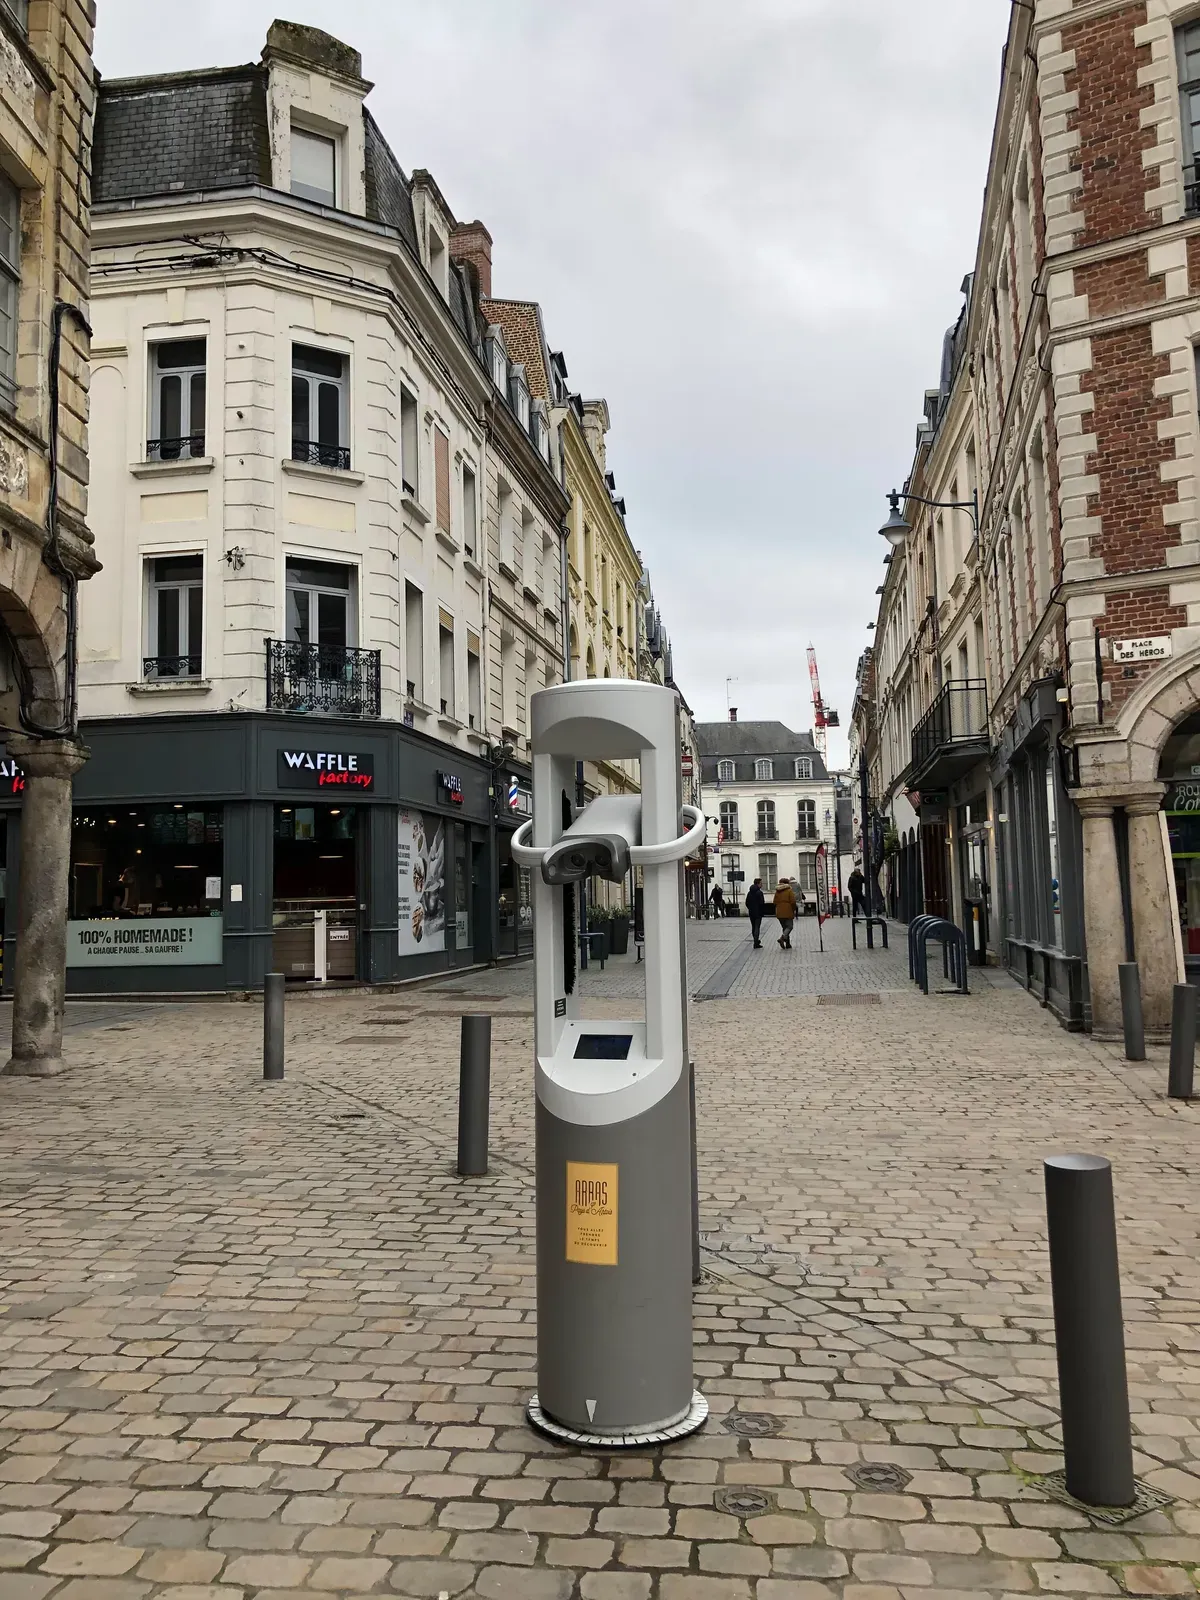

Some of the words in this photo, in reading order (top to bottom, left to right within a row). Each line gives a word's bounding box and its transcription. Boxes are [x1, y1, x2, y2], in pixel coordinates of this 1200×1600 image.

[1120, 651, 1134, 659] DES
[283, 751, 358, 771] WAFFLE
[319, 770, 372, 787] factory
[78, 930, 112, 944] 100%
[114, 928, 186, 944] HOMEMADE
[93, 946, 118, 955] CHAQUE
[154, 945, 180, 953] GAUFRE
[575, 1180, 608, 1206] ARRAS
